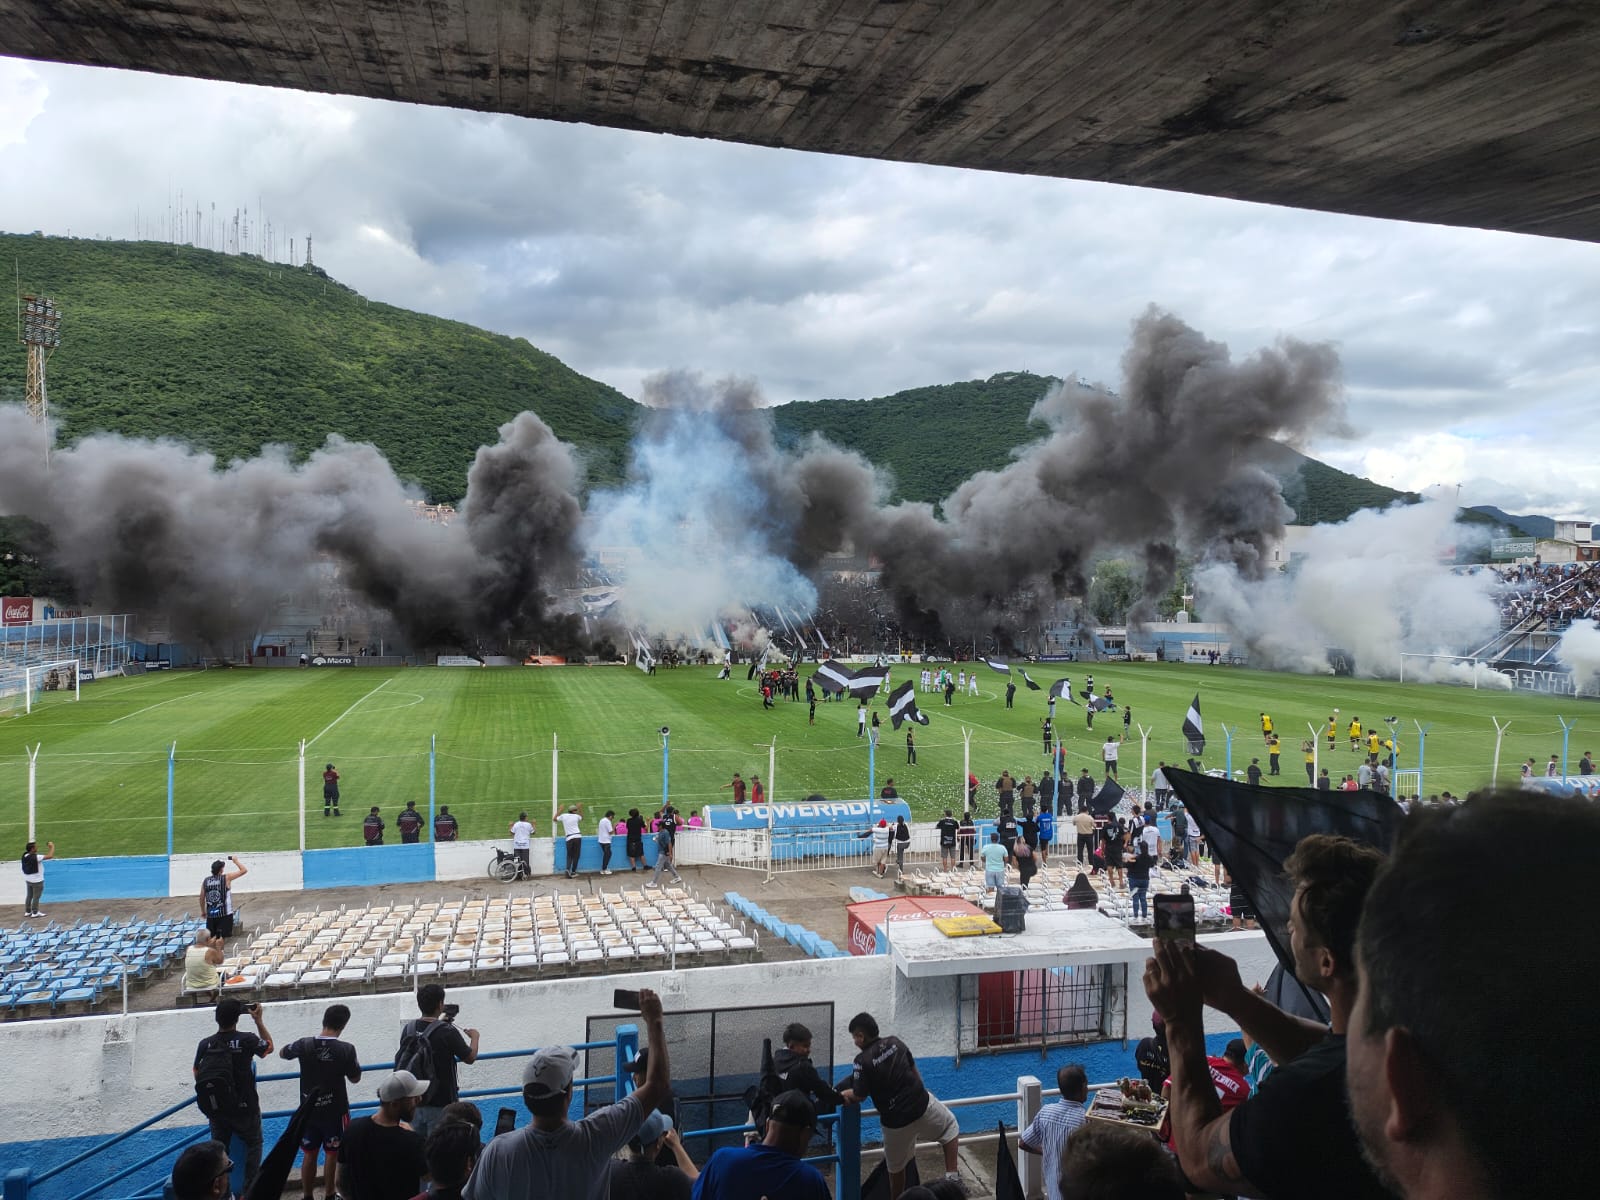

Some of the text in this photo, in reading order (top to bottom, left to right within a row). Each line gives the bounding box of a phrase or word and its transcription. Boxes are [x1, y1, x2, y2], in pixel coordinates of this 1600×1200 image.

[6, 605, 29, 619] Coca-Cola
[736, 803, 881, 820] POWERADE
[884, 911, 968, 922] oca-Cola
[1208, 1065, 1240, 1094] EPERNICK
